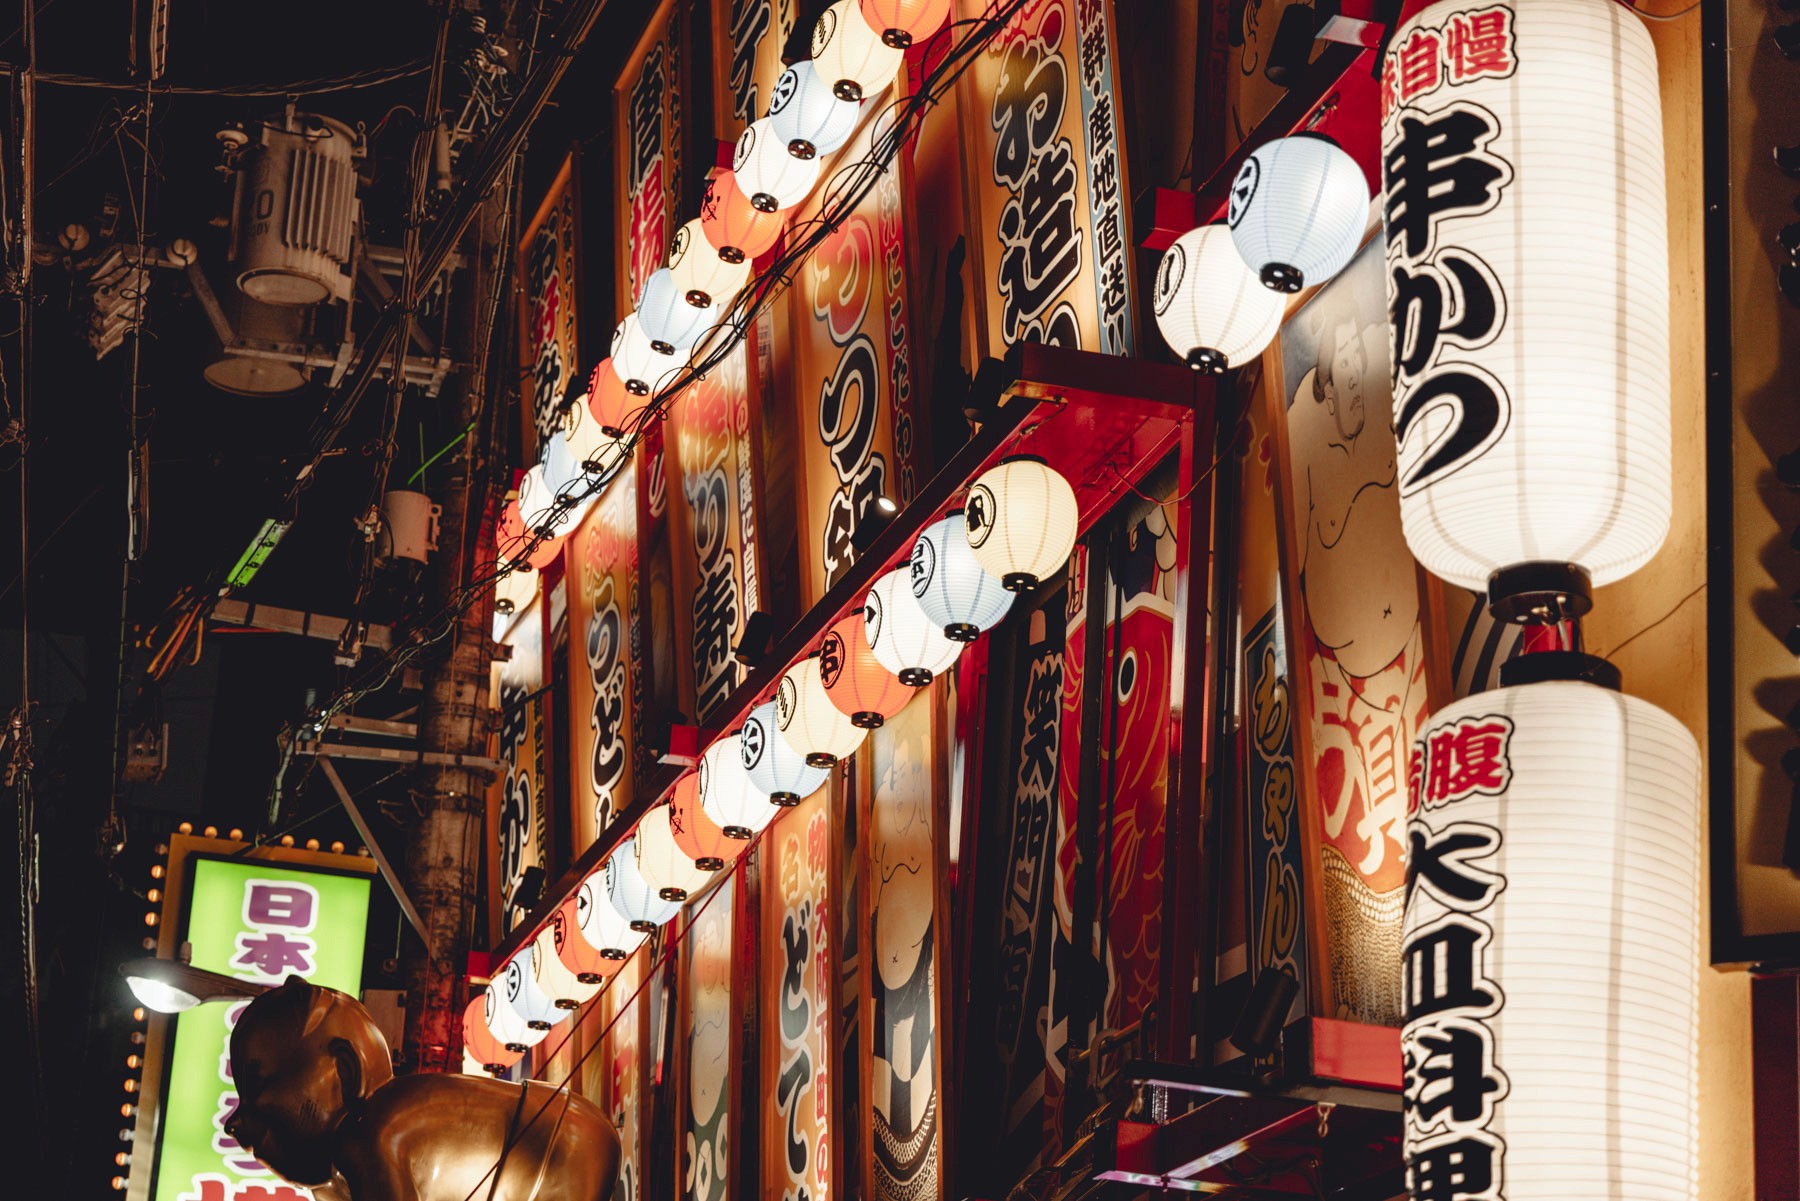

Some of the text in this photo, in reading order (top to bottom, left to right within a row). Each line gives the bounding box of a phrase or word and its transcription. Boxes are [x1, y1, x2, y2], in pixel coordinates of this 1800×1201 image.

[1382, 104, 1514, 496] 串かつ
[1253, 641, 1301, 980] ちゃん
[777, 892, 814, 1201] どて
